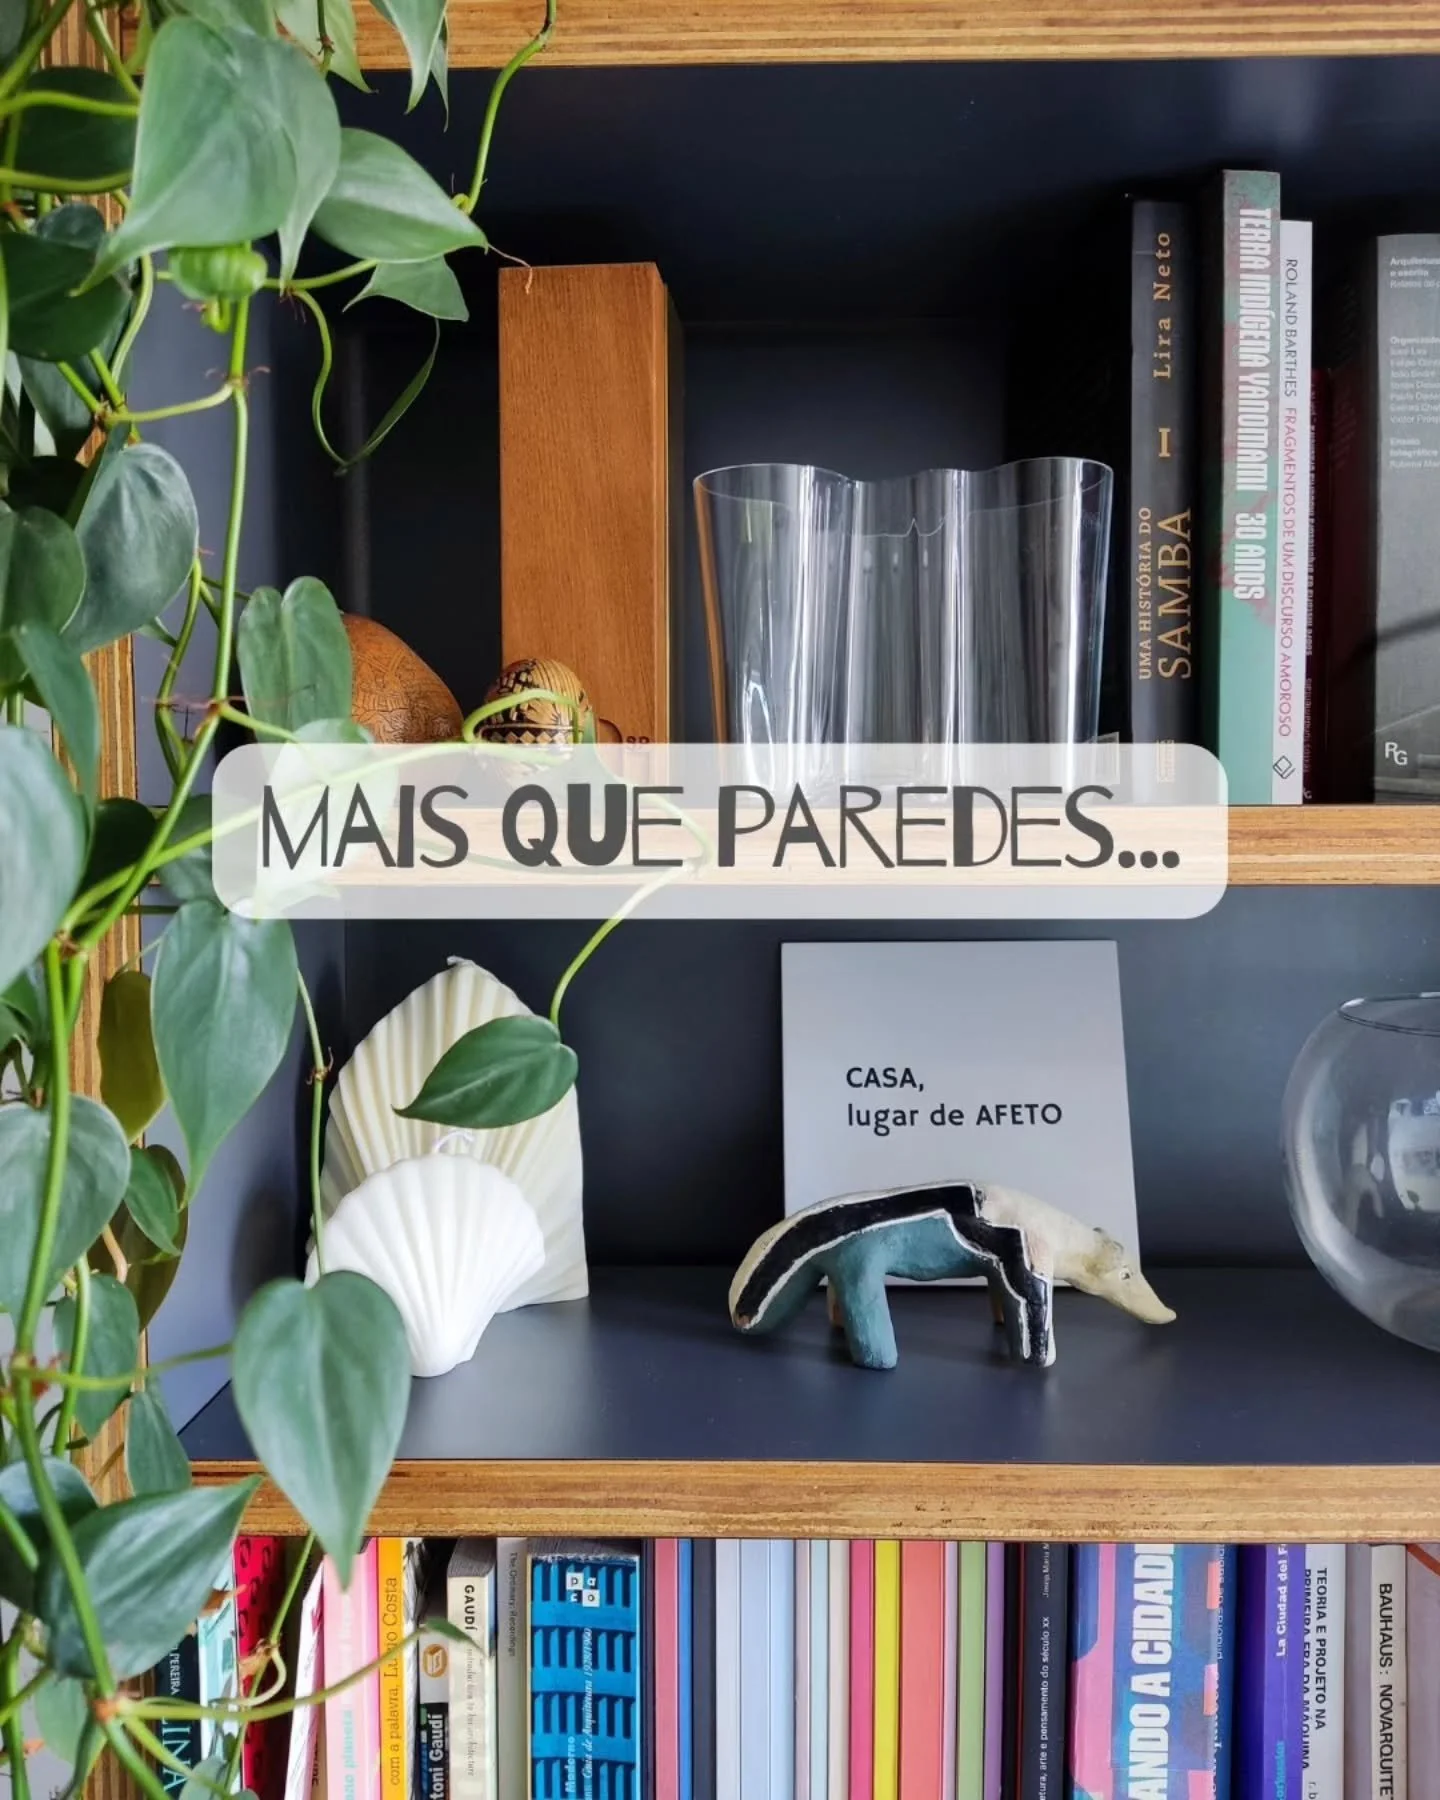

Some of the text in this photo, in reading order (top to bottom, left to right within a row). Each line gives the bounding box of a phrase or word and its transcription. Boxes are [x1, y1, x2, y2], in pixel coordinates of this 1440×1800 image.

[1152, 232, 1172, 380] Lira Neto
[1233, 207, 1275, 601] TERRA INDÍGENA YANOMAMI 30 ANOS
[1158, 427, 1171, 457] I
[1278, 259, 1298, 737] ROLAND BARTHES FRAGMENTOS DE UM DISCURSO AMOROSO
[1136, 507, 1152, 680] UMA HISTÓRIA DO
[1157, 507, 1192, 680] SAMBA
[846, 1067, 924, 1092] CASA,
[848, 1103, 1062, 1137] lugar de AFETO
[1277, 1559, 1288, 1580] del
[464, 1584, 478, 1631] GAUDÍ
[1276, 1585, 1288, 1635] Ciudad
[1040, 1631, 1050, 1663] século
[1276, 1638, 1287, 1657] La
[1314, 1568, 1328, 1730] TEORIA E PROJETO NA
[170, 1653, 181, 1695] PEREIRA
[382, 1577, 402, 1786] com a palavra, Lio Costa
[1040, 1665, 1049, 1678] do
[1130, 1671, 1171, 1697] A
[1040, 1680, 1050, 1741] pensamento
[428, 1713, 444, 1762] Gaudí
[581, 1739, 592, 1751] de
[1039, 1751, 1048, 1771] arte
[564, 1736, 575, 1792] Moderno
